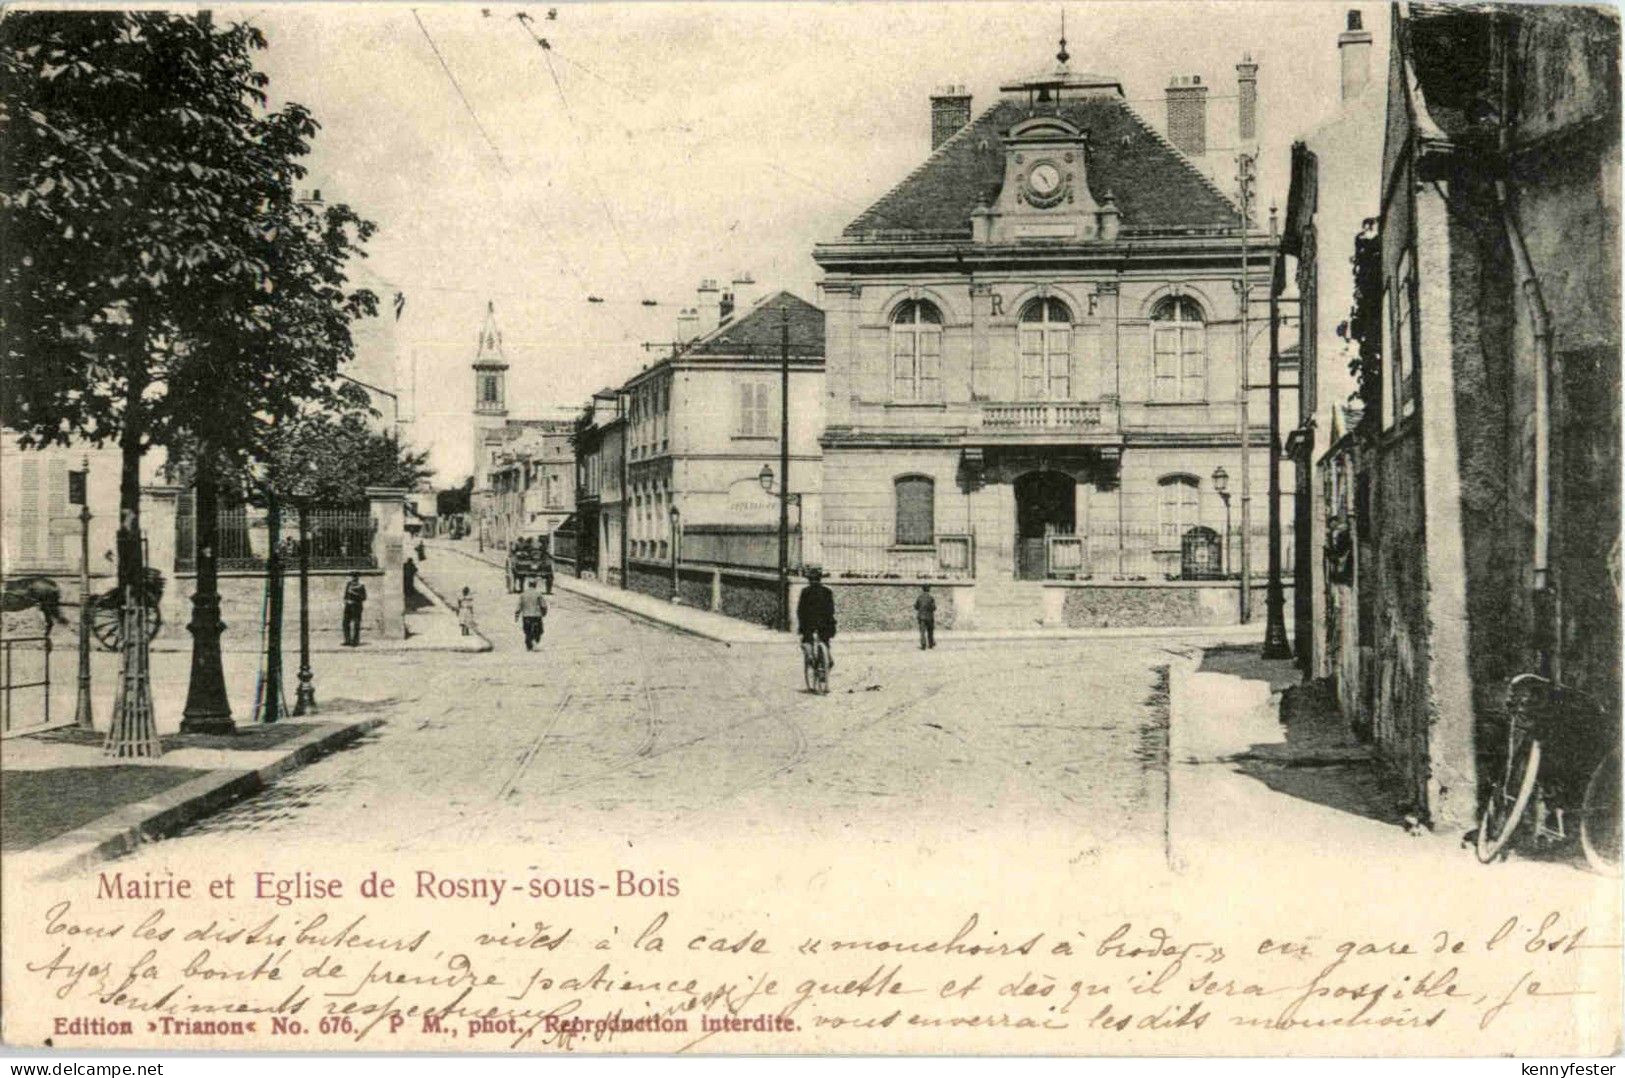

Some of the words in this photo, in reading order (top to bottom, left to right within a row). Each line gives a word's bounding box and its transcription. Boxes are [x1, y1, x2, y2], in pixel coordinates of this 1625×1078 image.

[990, 293, 1005, 316] R
[132, 907, 176, 941] les
[595, 925, 619, 950] à
[633, 911, 669, 951] la
[687, 929, 770, 953] case
[1051, 931, 1086, 955] à
[1336, 940, 1417, 978] gare
[1434, 930, 1467, 954] de
[183, 948, 291, 981] bonté
[302, 955, 347, 978] de
[325, 953, 505, 996] prendre
[939, 974, 984, 998] et
[998, 970, 1057, 997] dès
[814, 1009, 901, 1029] vous
[907, 1004, 1069, 1030] enverrai
